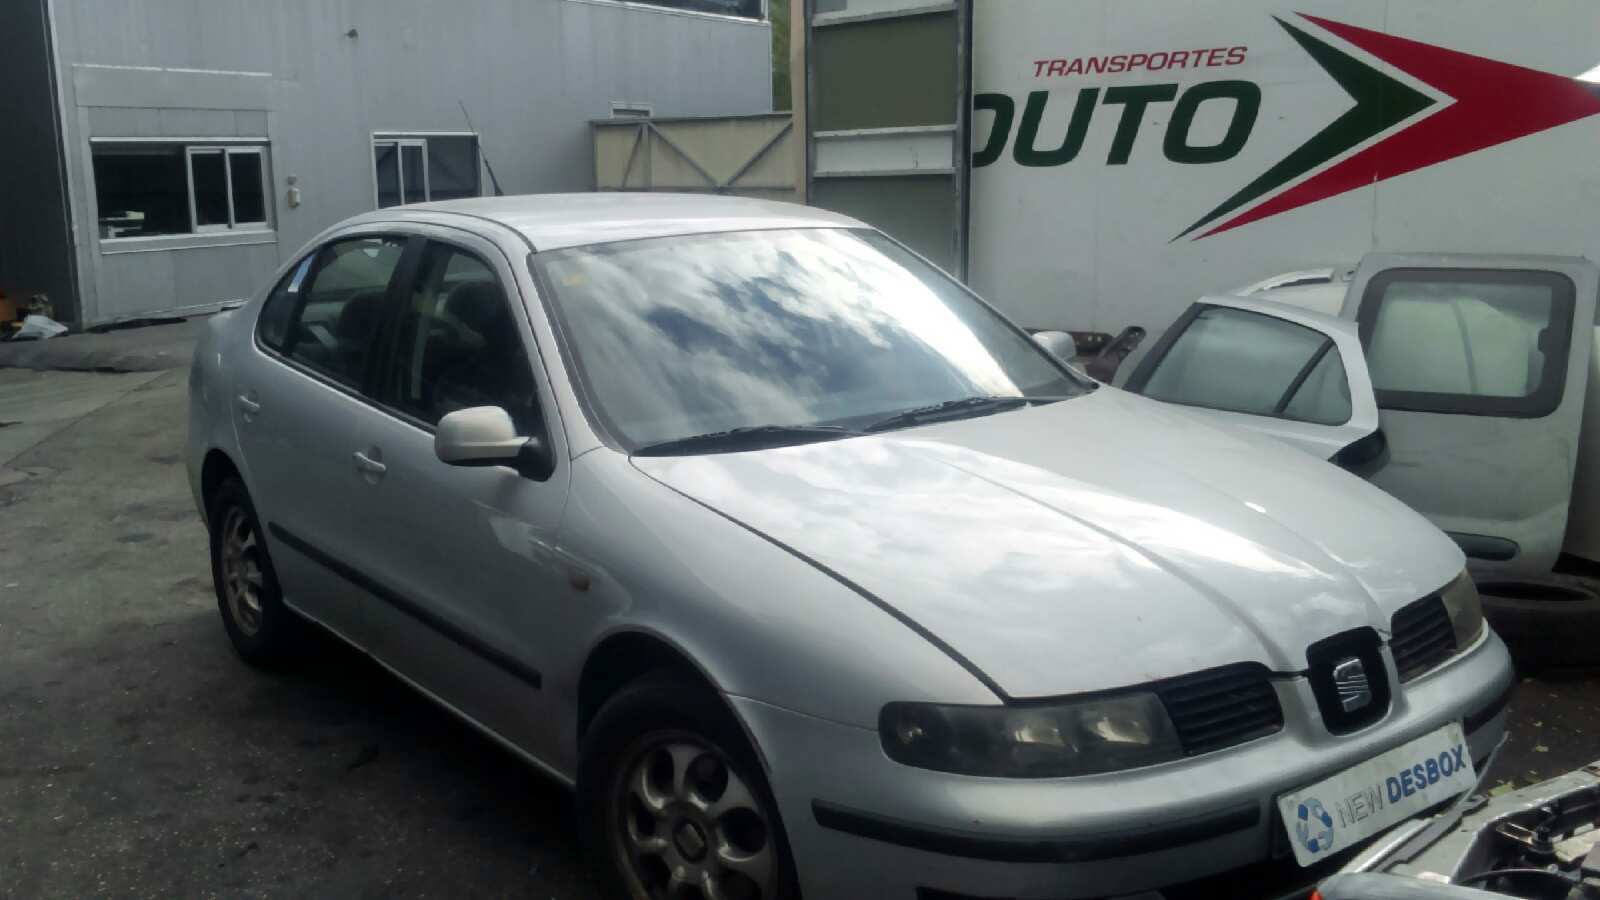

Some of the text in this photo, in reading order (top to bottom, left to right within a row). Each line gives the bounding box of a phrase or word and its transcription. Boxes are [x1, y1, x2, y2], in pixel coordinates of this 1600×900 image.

[1033, 46, 1248, 77] TRANSPORTES
[1336, 744, 1466, 828] NEW DESBOX
